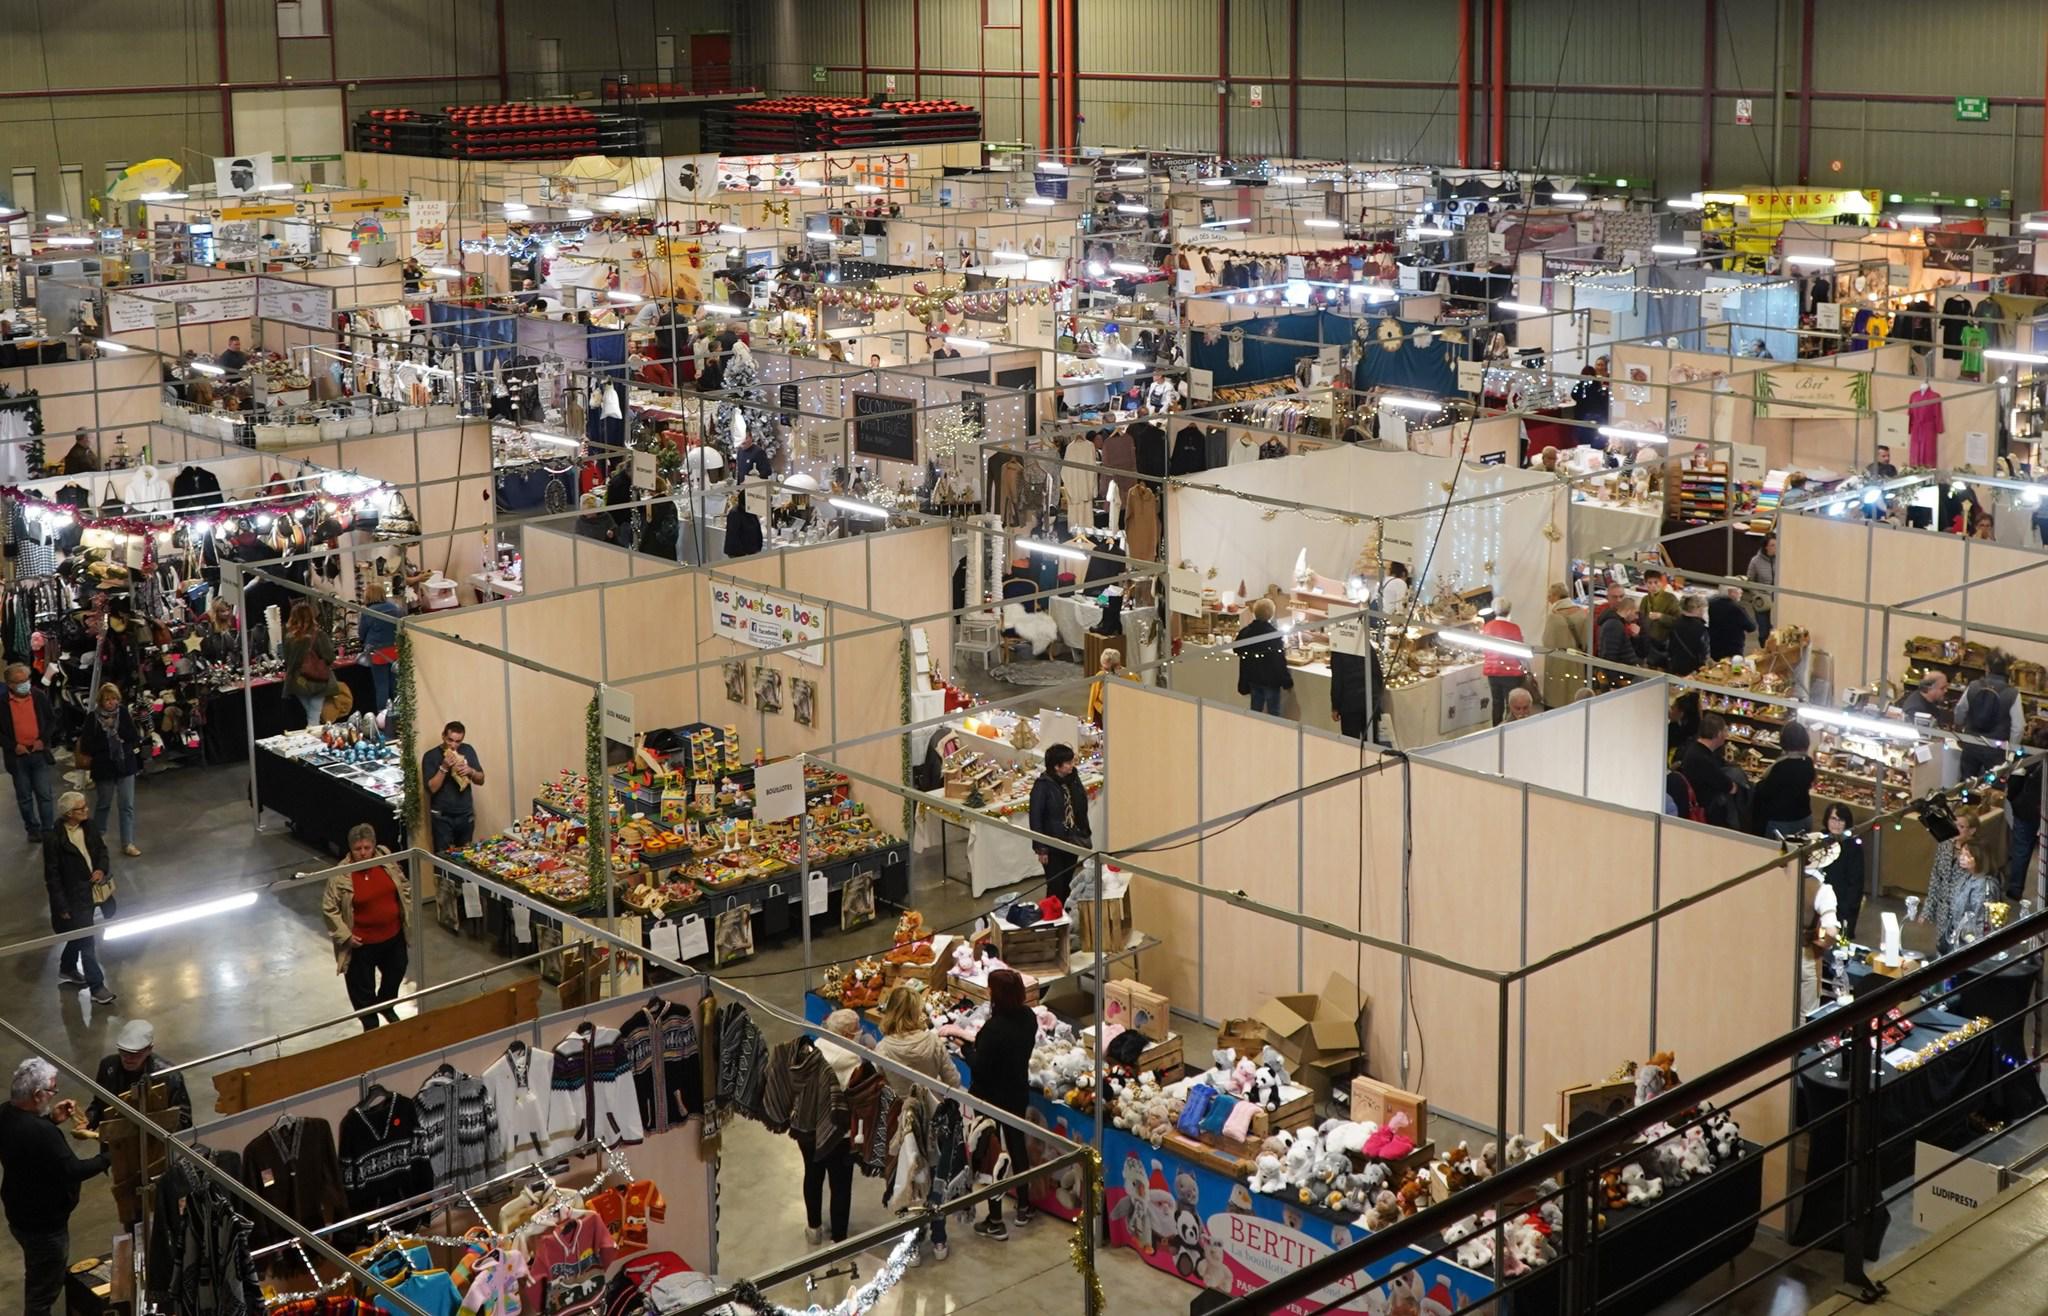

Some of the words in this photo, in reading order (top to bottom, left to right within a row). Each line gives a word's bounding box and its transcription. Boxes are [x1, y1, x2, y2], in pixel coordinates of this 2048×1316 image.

[774, 604, 792, 621] en
[792, 603, 820, 629] bois
[1932, 1185, 1978, 1209] LUDIPRESTA
[1230, 1216, 1358, 1291] BERTILA
